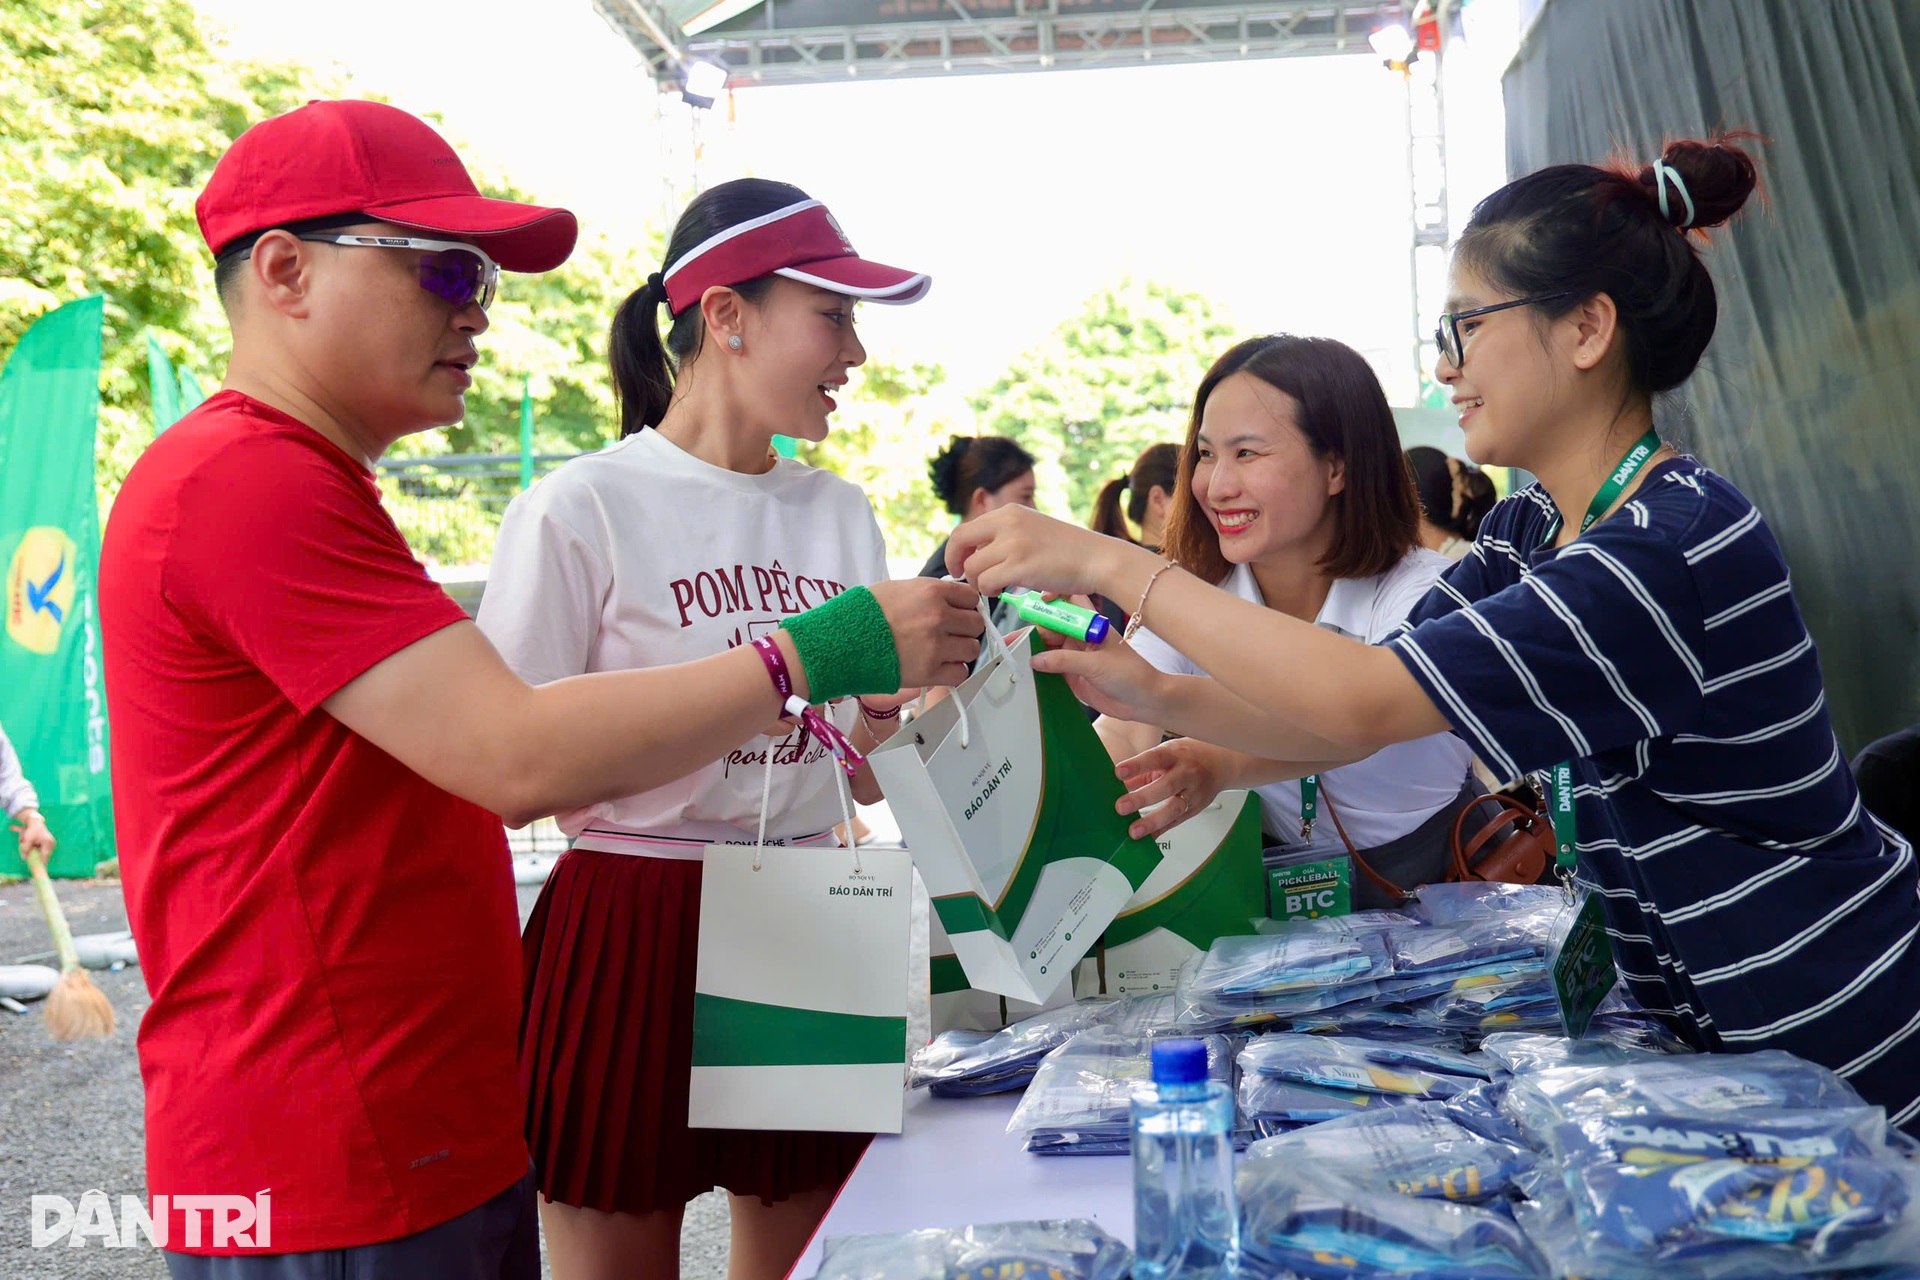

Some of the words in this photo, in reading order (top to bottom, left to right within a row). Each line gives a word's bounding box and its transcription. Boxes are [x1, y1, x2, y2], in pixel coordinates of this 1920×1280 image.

[670, 565, 753, 627] POM
[751, 560, 847, 614] PÊCH
[723, 734, 797, 779] ports
[964, 800, 984, 821] BÁO
[982, 775, 1001, 800] DÂN
[997, 756, 1012, 779] TRÍ
[829, 884, 850, 896] BÁO
[852, 885, 874, 897] DÂN
[876, 886, 893, 897] TRÍ
[1278, 869, 1341, 887] PICKLEBALL
[1285, 890, 1335, 914] BTC
